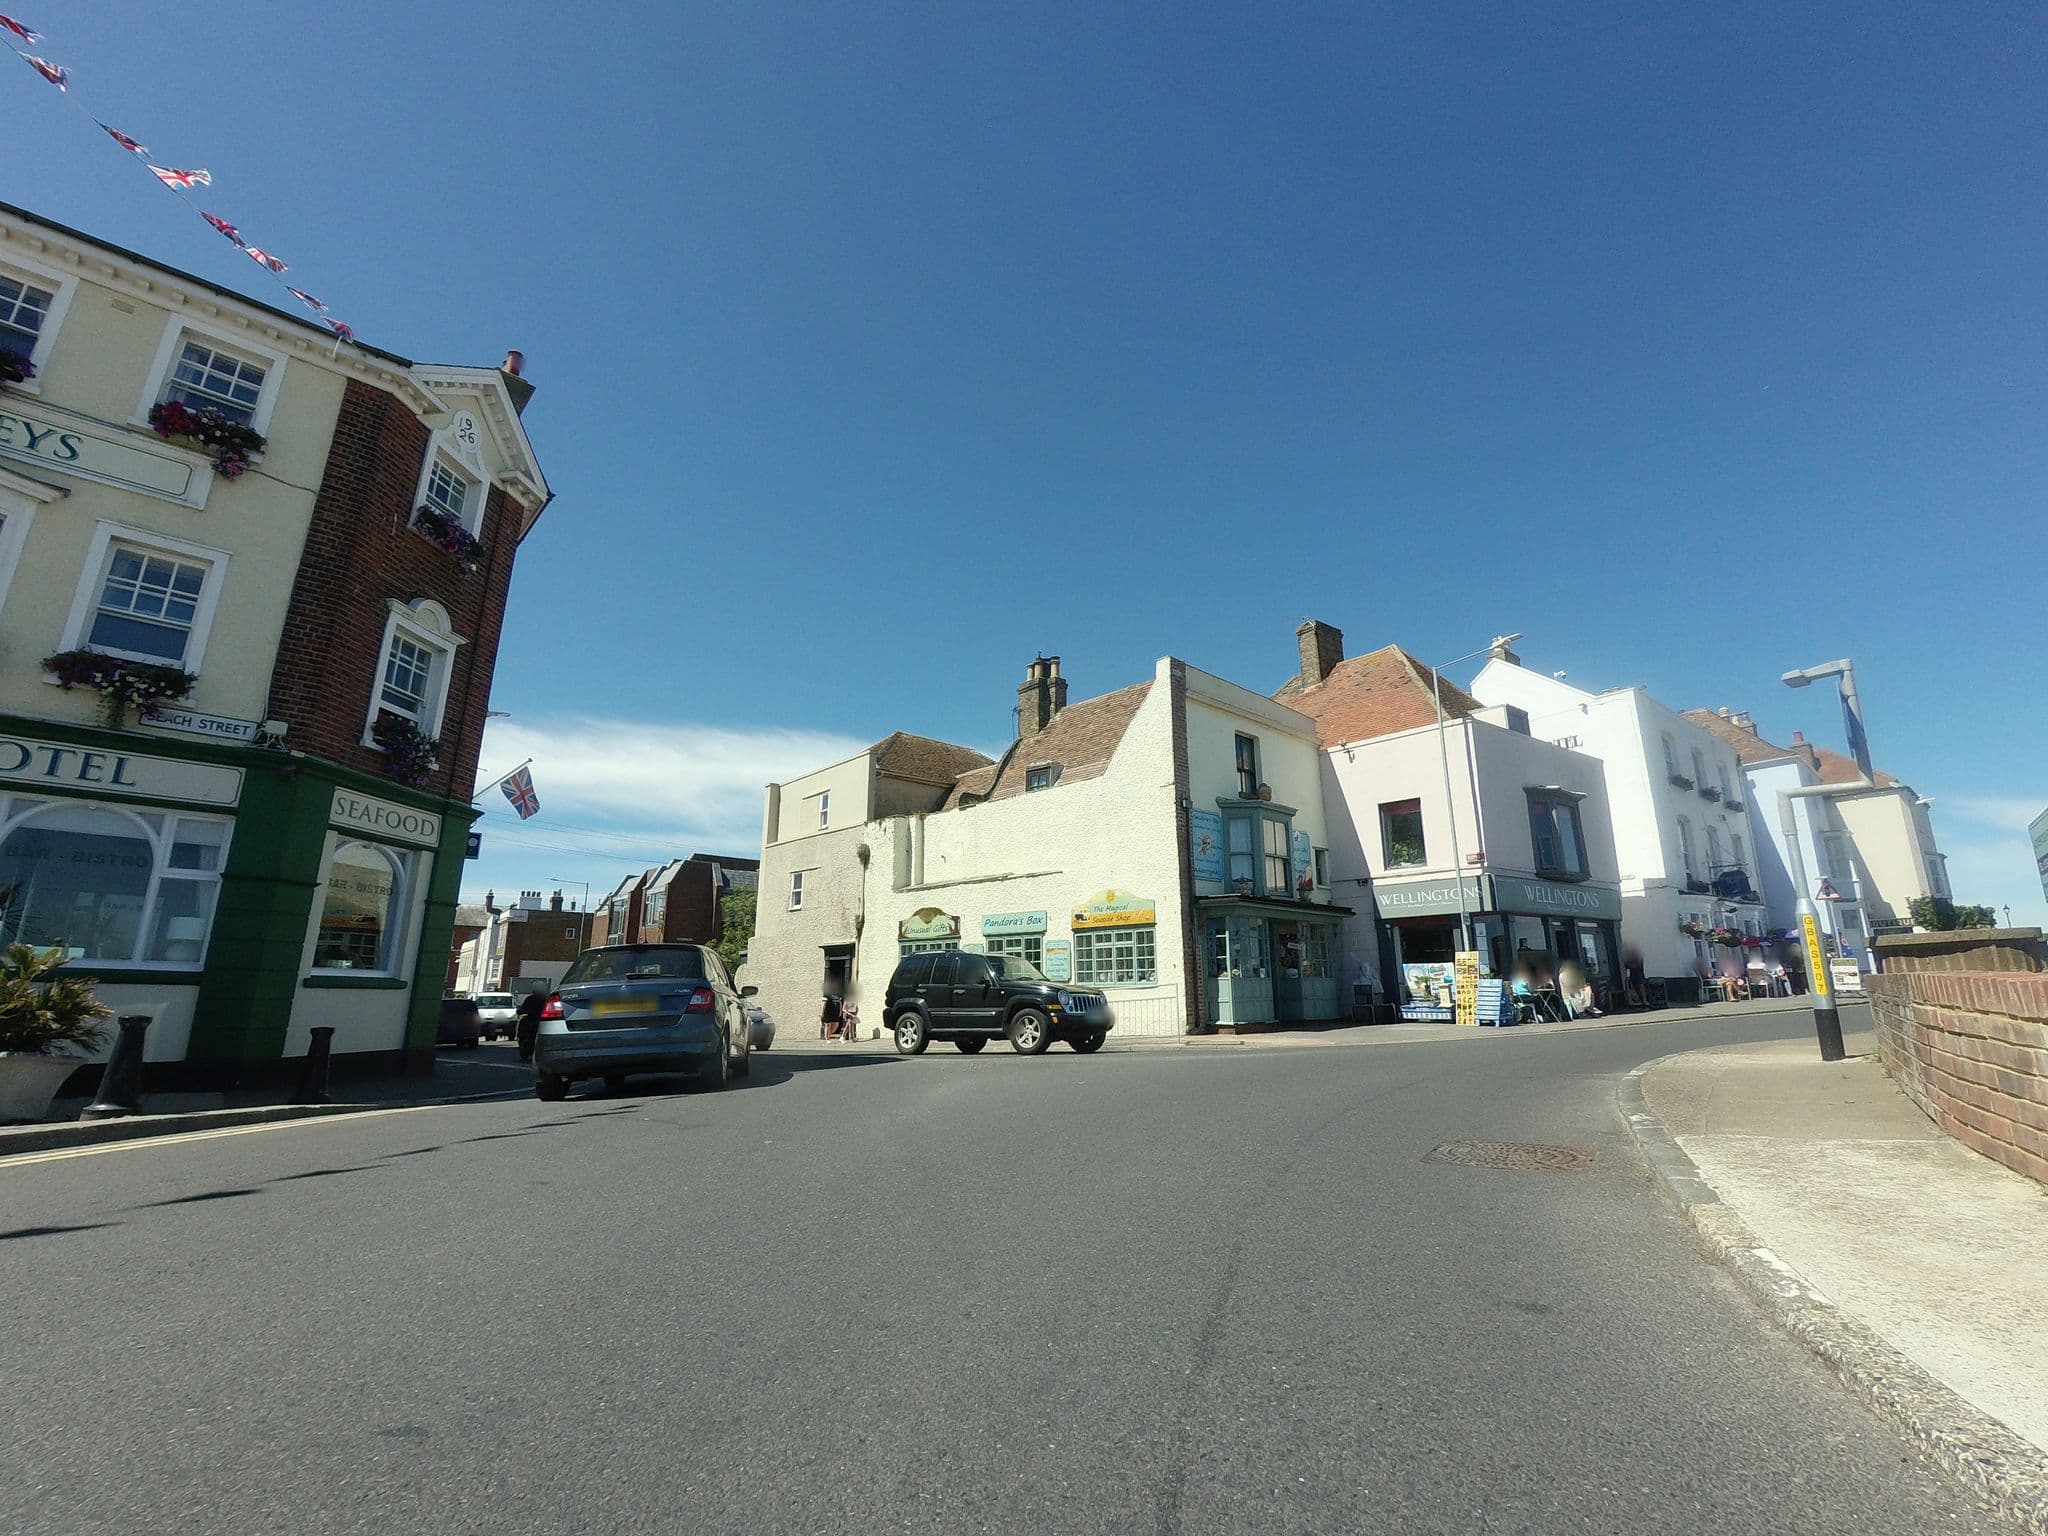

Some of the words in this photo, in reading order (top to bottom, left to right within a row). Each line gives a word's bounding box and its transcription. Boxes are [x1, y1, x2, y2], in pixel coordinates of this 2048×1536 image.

[198, 718, 251, 736] STREET
[335, 796, 435, 837] SEAFOOD
[1379, 886, 1482, 906] WELLINGTONS
[1523, 884, 1599, 908] WELLINGTONS
[984, 916, 1024, 928] Pandora's
[1026, 915, 1043, 926] Box
